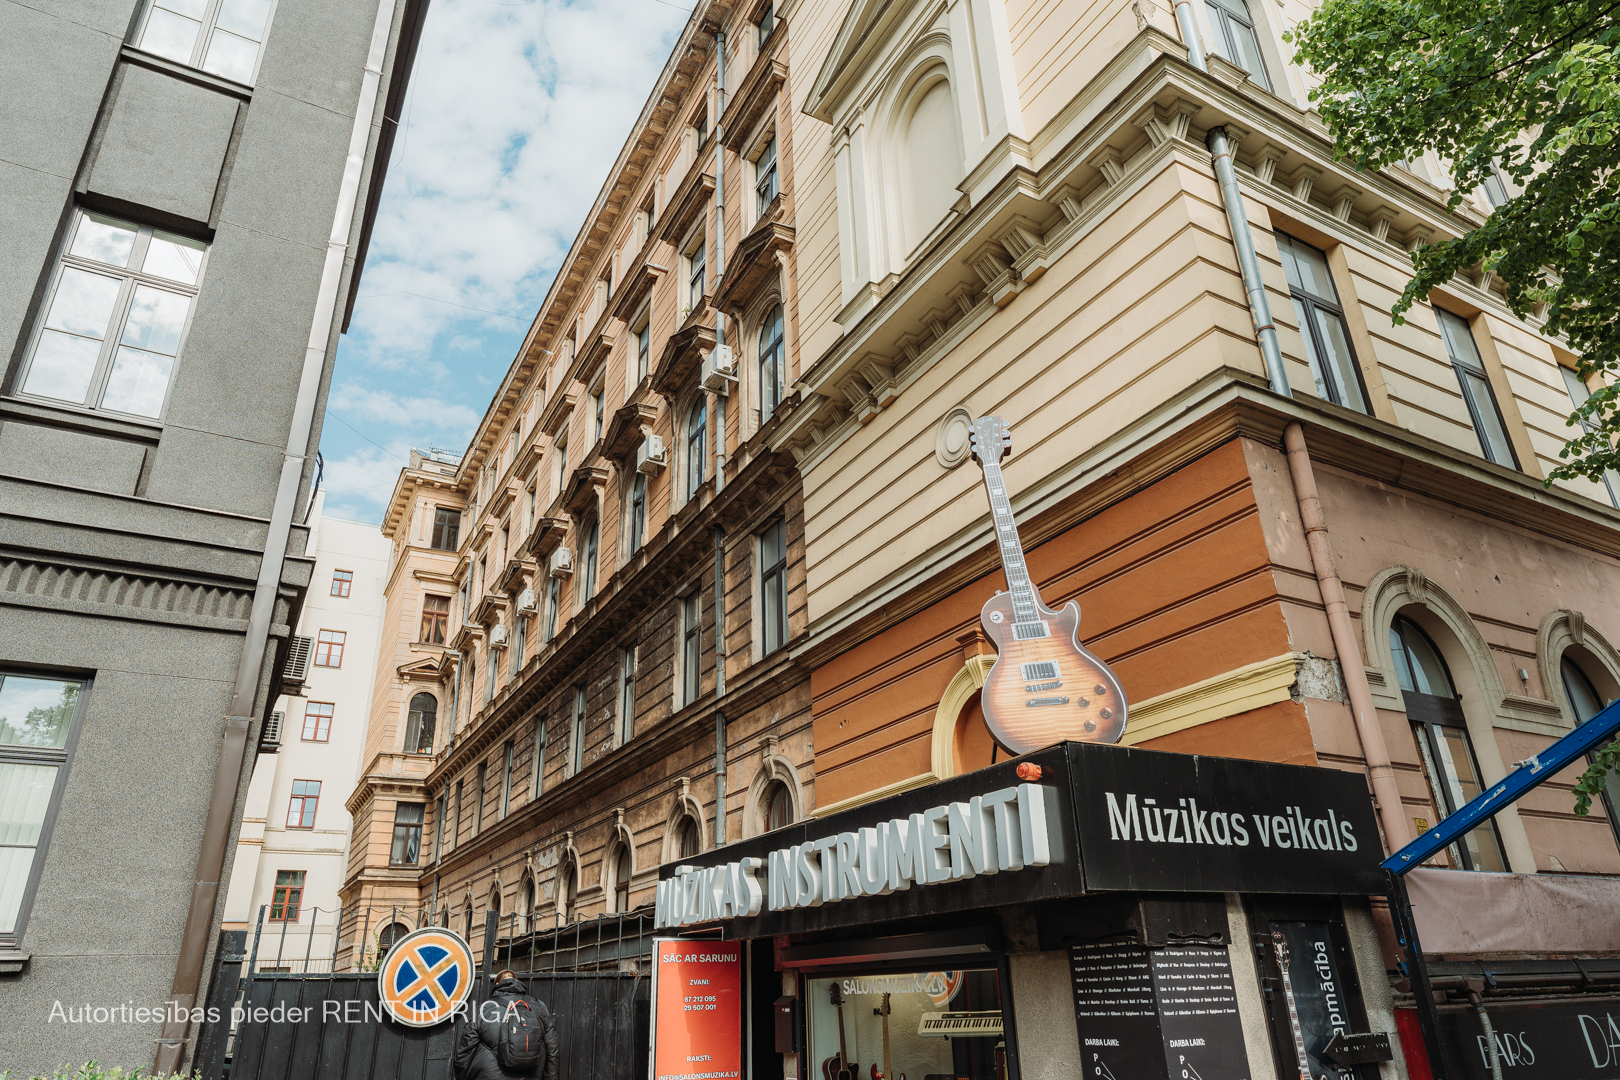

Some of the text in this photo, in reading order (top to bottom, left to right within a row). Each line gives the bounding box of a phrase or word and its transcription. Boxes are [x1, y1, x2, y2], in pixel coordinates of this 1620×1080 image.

[1104, 792, 1358, 852] Mūzikas veikals
[654, 783, 1050, 929] MŪZIKAS INSTRUMENTI
[662, 953, 737, 963] SĀC AR SARUNU
[843, 976, 944, 996] SALONSMUZIKA.LV
[1093, 1053, 1099, 1062] P
[1180, 1055, 1185, 1064] P
